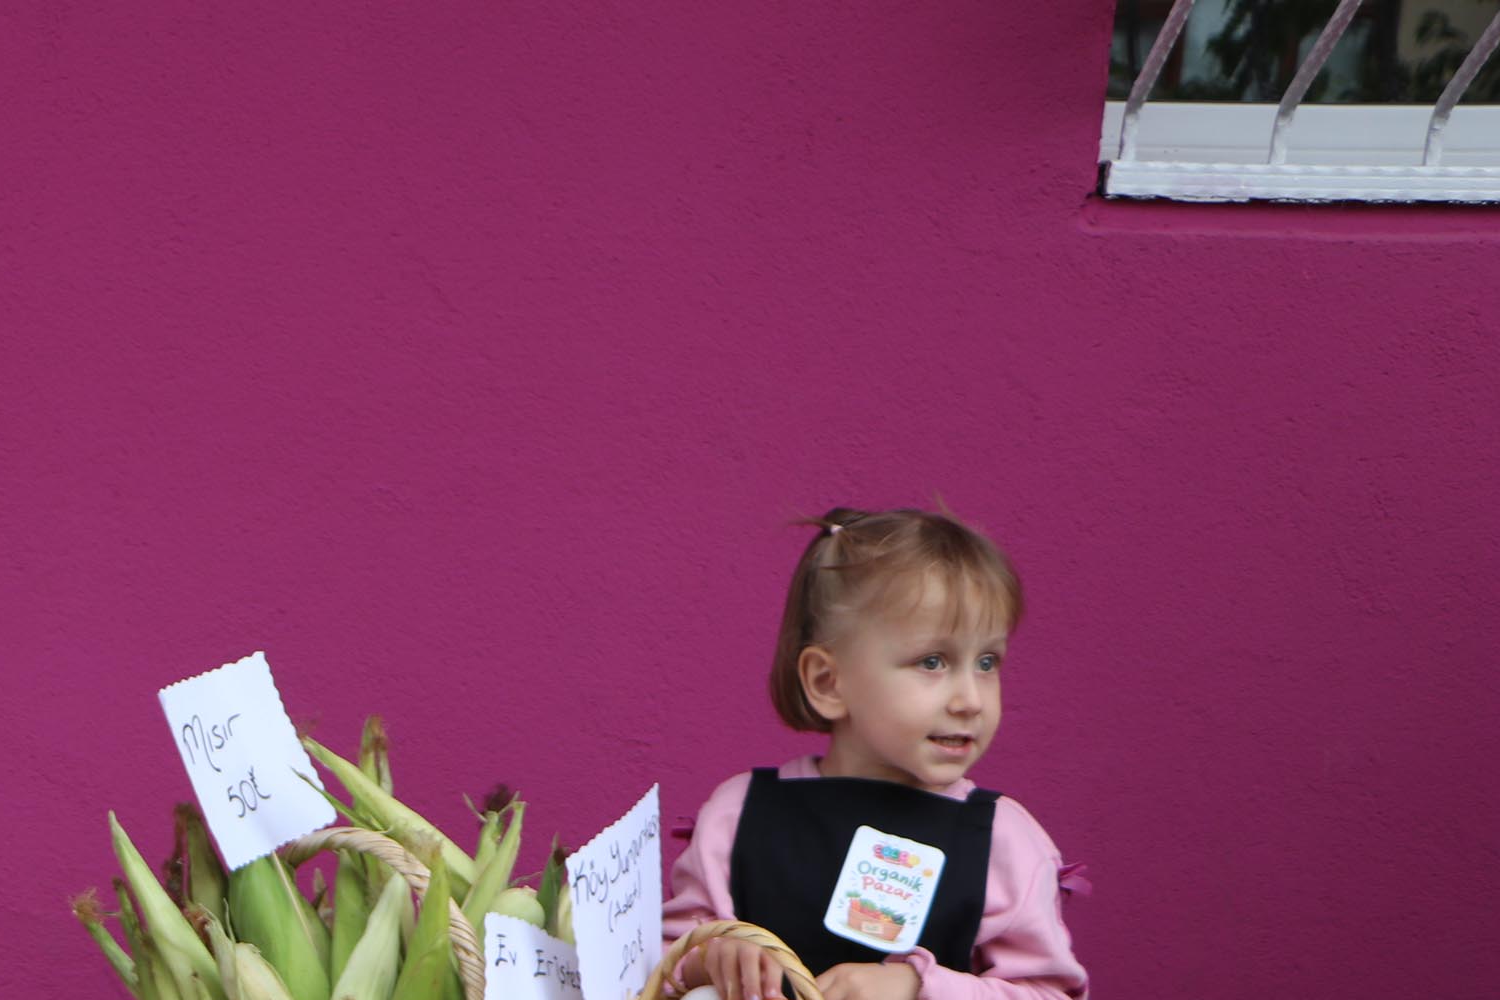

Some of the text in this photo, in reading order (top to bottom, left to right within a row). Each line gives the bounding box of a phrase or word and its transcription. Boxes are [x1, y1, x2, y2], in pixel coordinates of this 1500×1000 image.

[858, 861, 924, 892] Organik
[861, 876, 914, 900] Pazar
[495, 934, 517, 966] Ev
